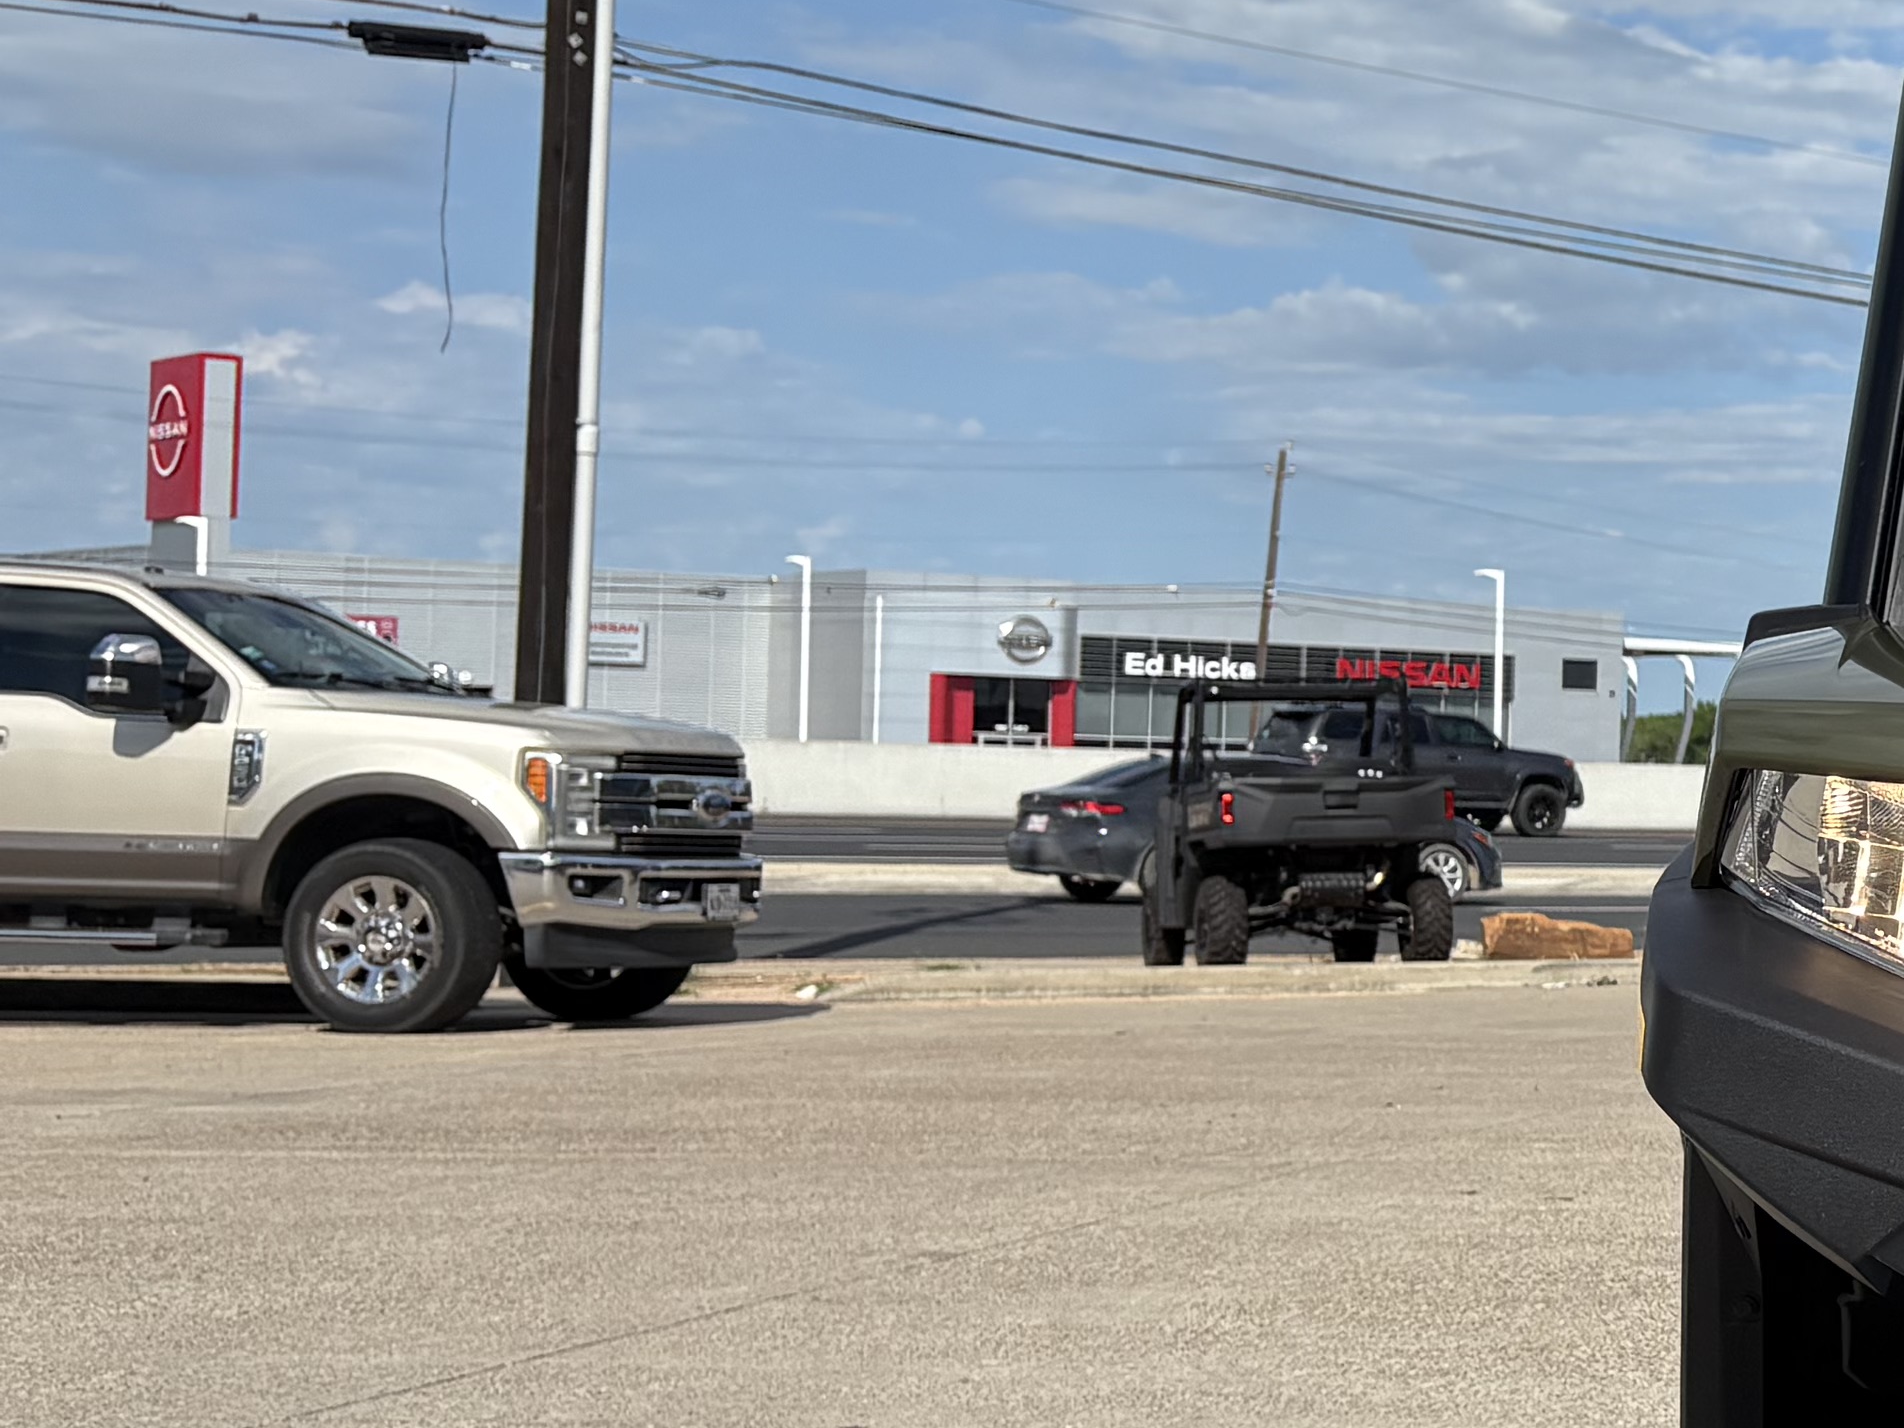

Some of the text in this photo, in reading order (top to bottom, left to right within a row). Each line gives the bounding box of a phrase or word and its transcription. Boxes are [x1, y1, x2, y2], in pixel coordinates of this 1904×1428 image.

[590, 621, 639, 634] ISSAN
[1124, 652, 1257, 680] Ed Hicks
[1335, 656, 1482, 690] NISSAN
